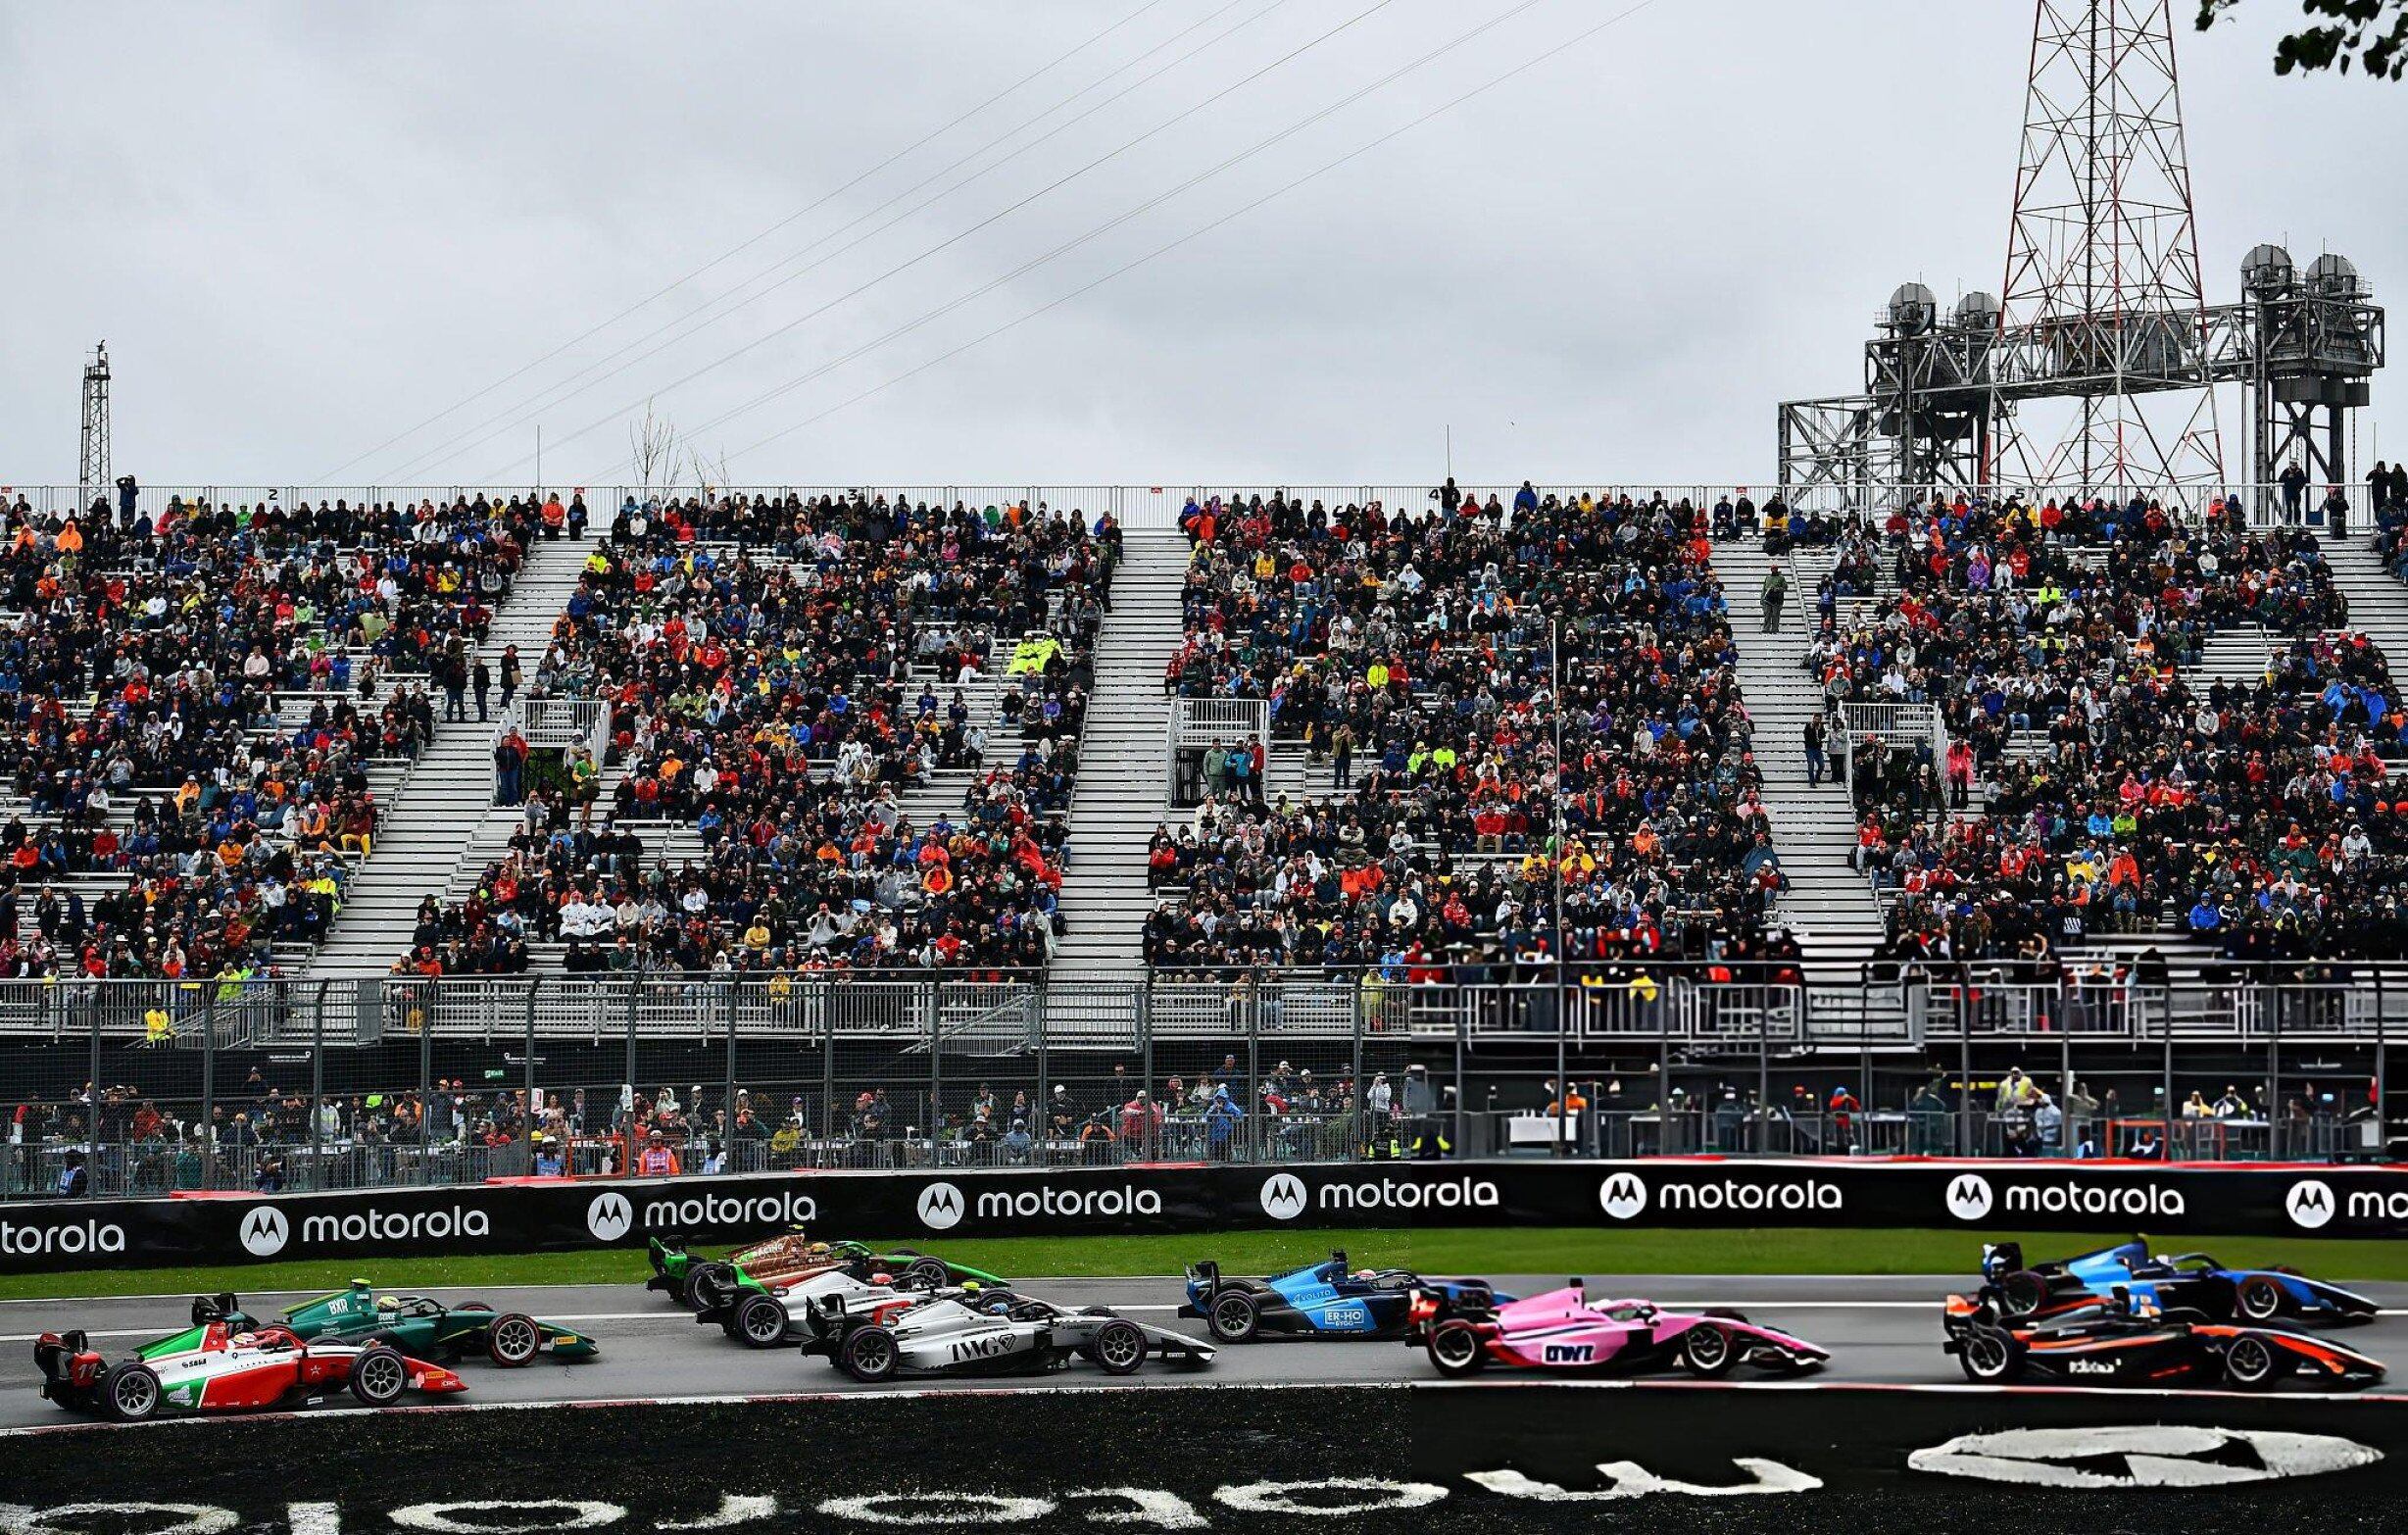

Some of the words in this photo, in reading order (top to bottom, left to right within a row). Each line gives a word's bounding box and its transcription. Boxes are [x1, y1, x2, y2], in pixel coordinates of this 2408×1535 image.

[269, 488, 278, 501] 2
[848, 488, 859, 501] 3
[1428, 488, 1440, 501] 4
[2015, 488, 2026, 500] 5
[977, 1184, 1161, 1217] motorola
[1319, 1176, 1499, 1209] motorola
[1659, 1179, 1843, 1210] motorola
[2005, 1181, 2185, 1215] motorola
[645, 1191, 817, 1227] motorola
[1, 1218, 125, 1254] torola
[303, 1205, 489, 1242] motorola
[1327, 1312, 1360, 1321] ER-HO
[826, 1328, 843, 1342] 4
[947, 1337, 999, 1362] TWG
